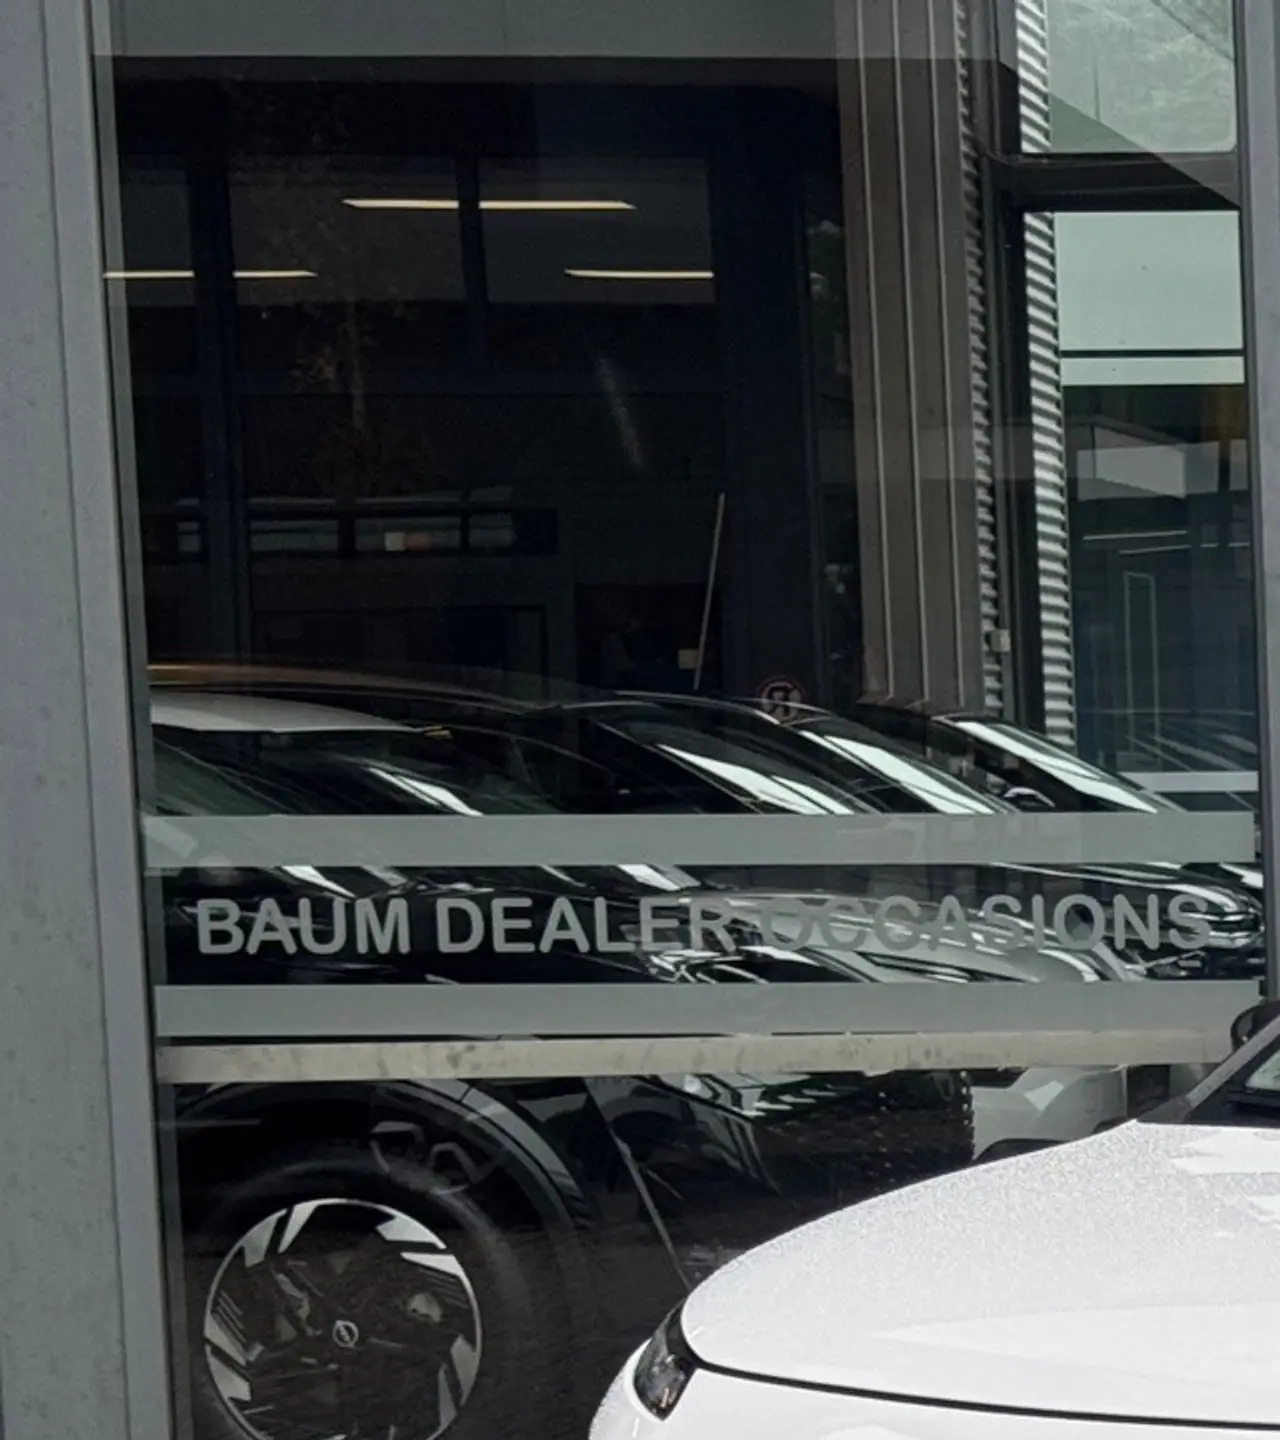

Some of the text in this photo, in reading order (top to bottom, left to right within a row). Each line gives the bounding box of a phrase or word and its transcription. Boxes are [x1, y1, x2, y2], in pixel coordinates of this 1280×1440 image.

[196, 893, 1211, 955] BAUM DEALER OCCASIONS
